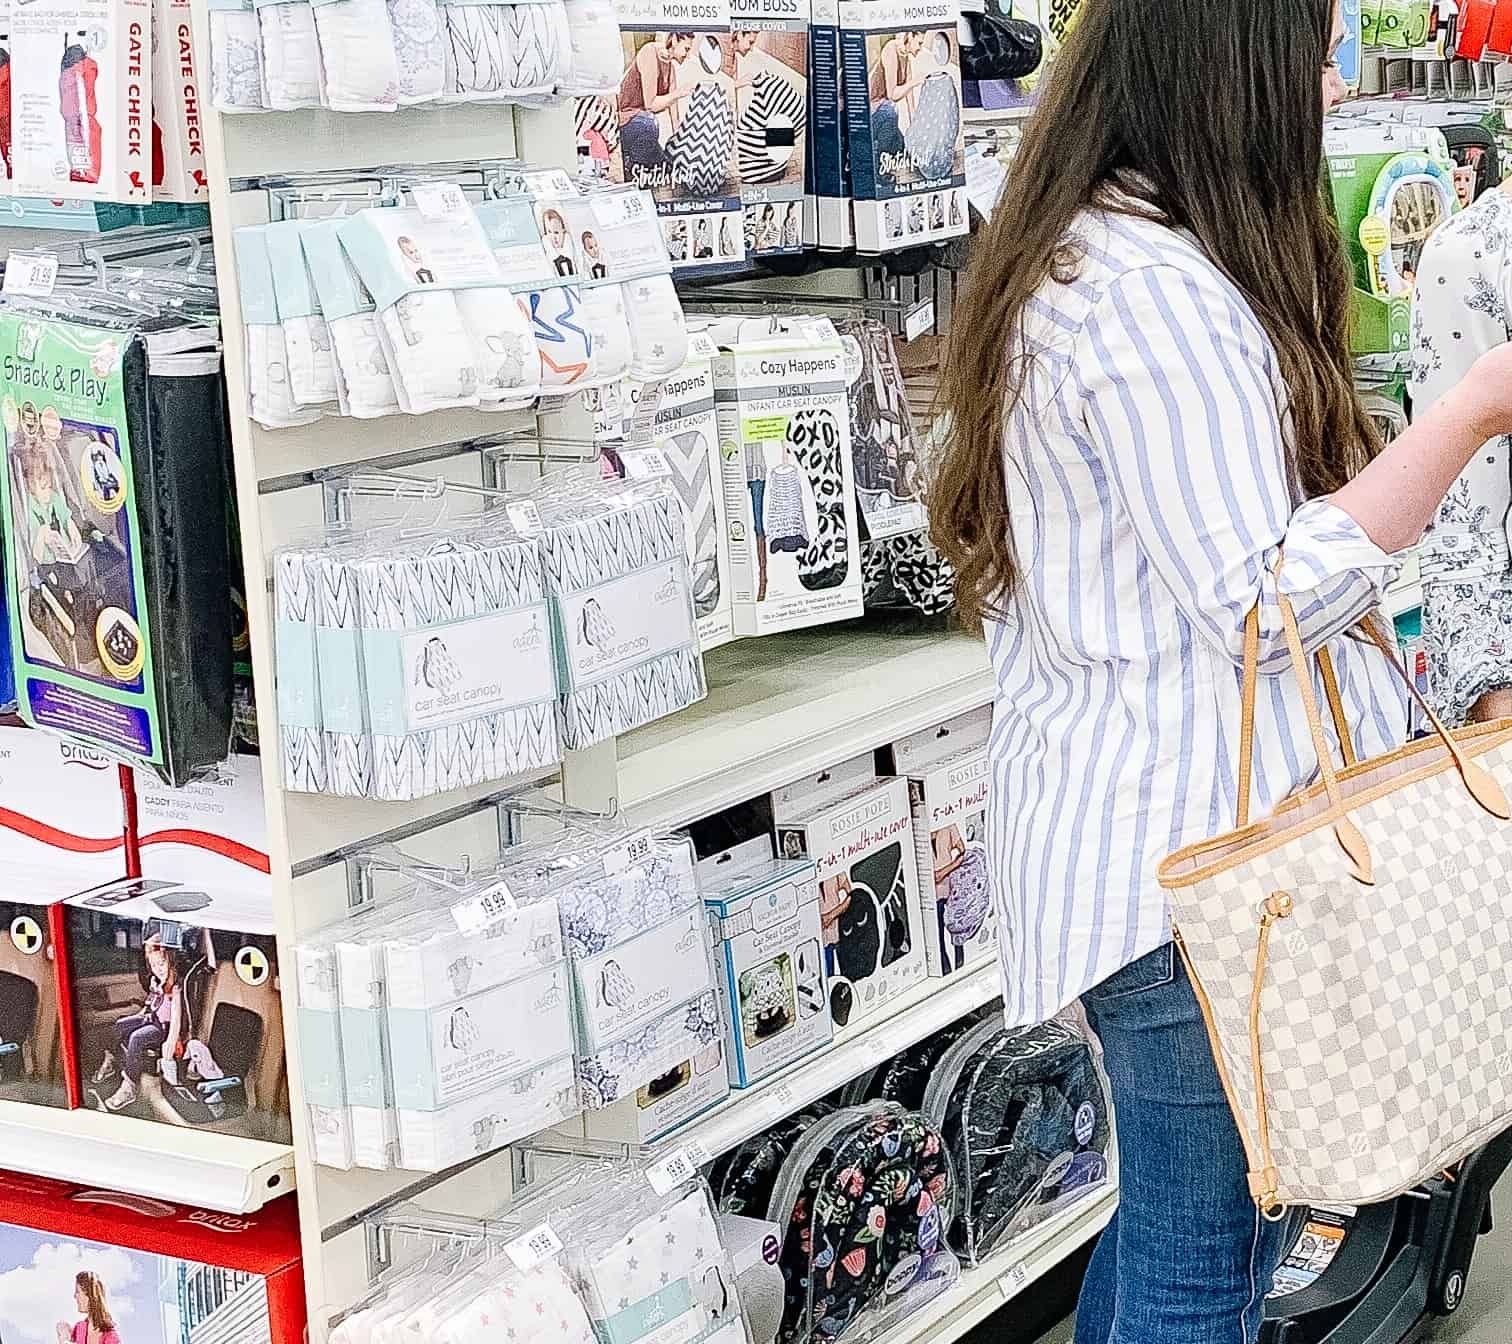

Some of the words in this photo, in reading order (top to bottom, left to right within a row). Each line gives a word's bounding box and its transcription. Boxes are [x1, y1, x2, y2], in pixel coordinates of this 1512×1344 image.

[663, 4, 690, 18] MOM
[904, 6, 925, 18] MOM
[128, 22, 142, 77] GATE
[177, 23, 193, 78] GATE
[128, 85, 140, 156] CHECK
[183, 85, 201, 156] CHECK
[631, 163, 670, 190] Stretch
[4, 355, 48, 389] Snack
[53, 364, 66, 393] &
[760, 361, 787, 377] Cozy
[663, 371, 706, 398] appens
[778, 385, 811, 396] MUSLIN
[778, 399, 793, 409] CAR
[794, 398, 813, 408] SEAT
[814, 395, 842, 407] CANOPY
[654, 407, 682, 424] USLIN
[665, 420, 684, 432] SEAT
[685, 414, 712, 428] CANOPY
[415, 697, 434, 712] car
[437, 692, 463, 707] seat
[949, 766, 978, 786] ROSIE
[831, 811, 861, 834] ROSIE
[626, 838, 649, 859] 19.99
[817, 850, 846, 874] 5-in-1
[888, 814, 909, 838] cover
[480, 891, 507, 914] 19.99
